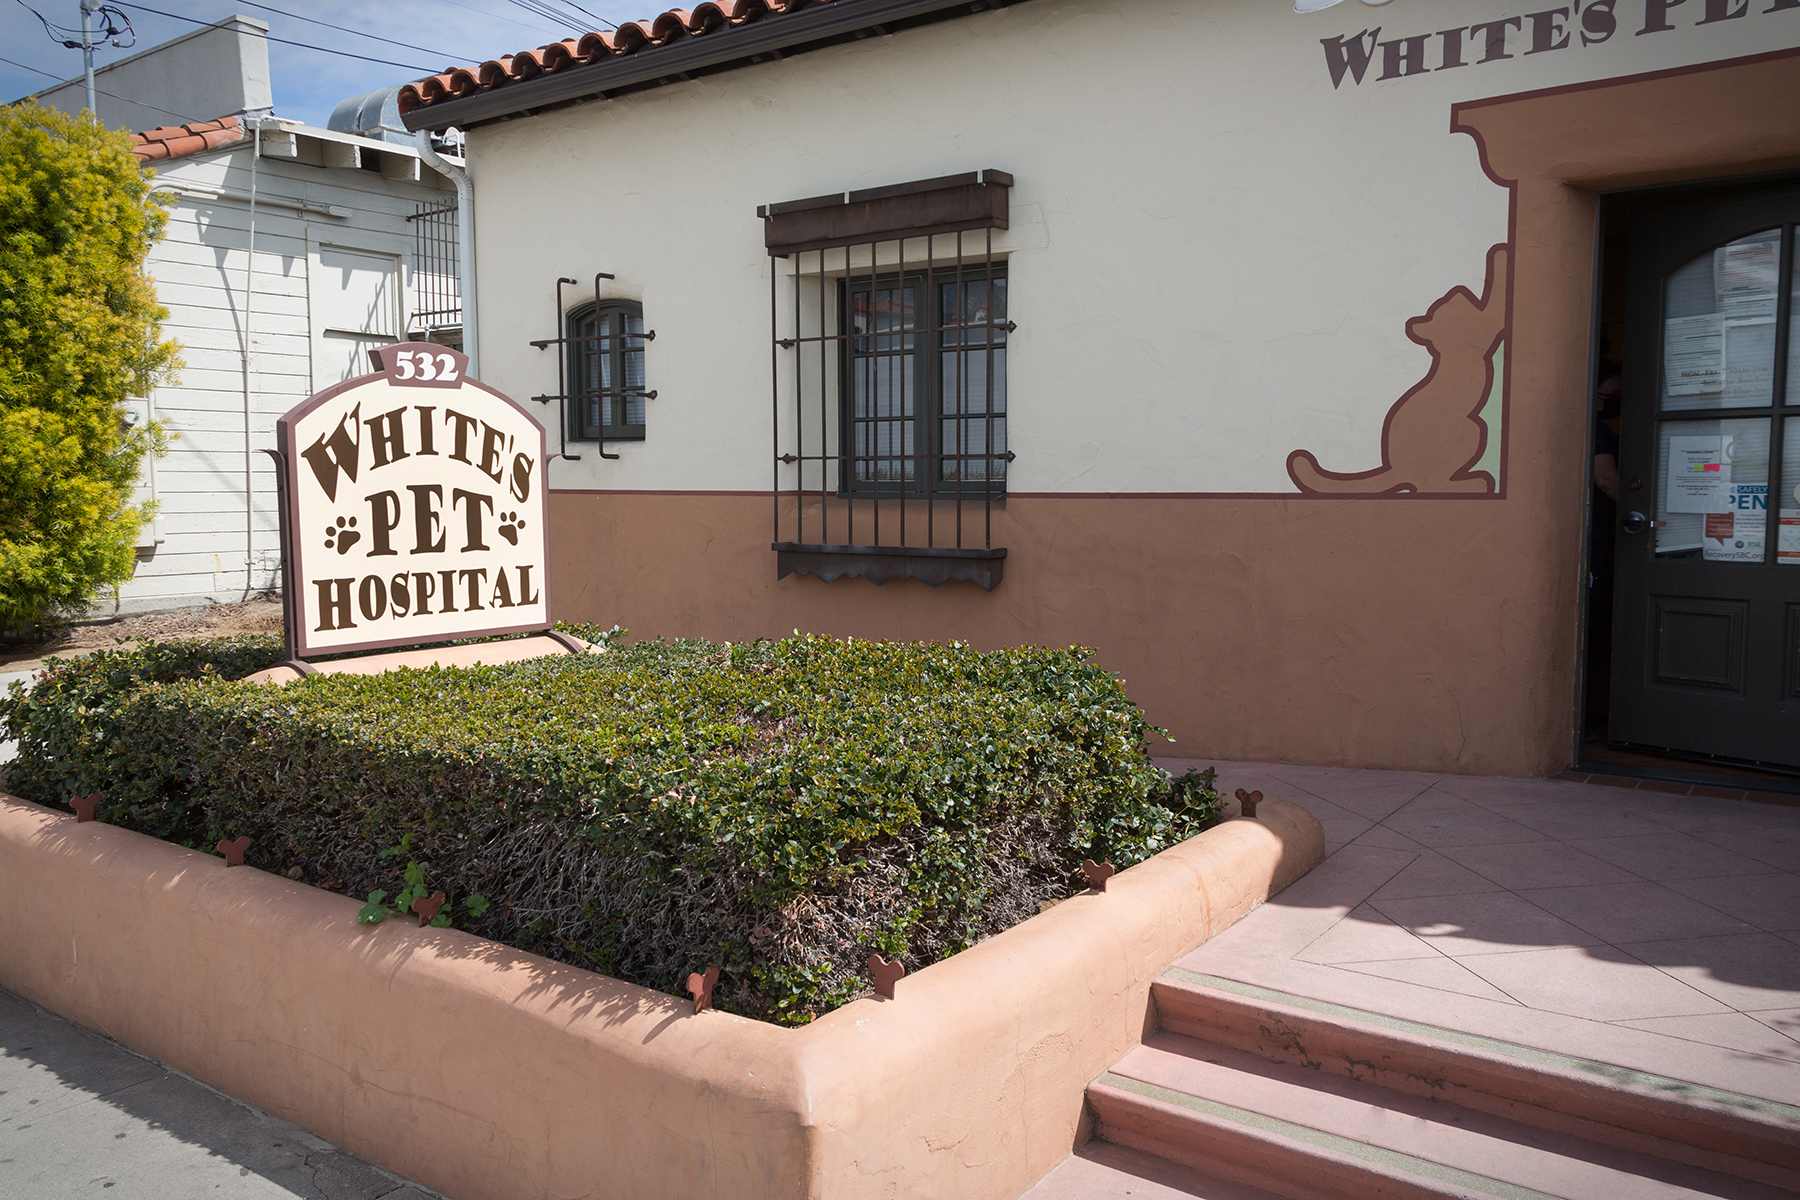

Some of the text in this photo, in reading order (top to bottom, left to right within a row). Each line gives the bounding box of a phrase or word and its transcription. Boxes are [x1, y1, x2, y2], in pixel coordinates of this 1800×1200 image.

[1320, 0, 1800, 90] WHITE'S PE
[395, 351, 459, 382] 532
[301, 400, 535, 504] WHITE'S
[364, 484, 494, 558] PET
[312, 564, 539, 632] HOSPITAL
